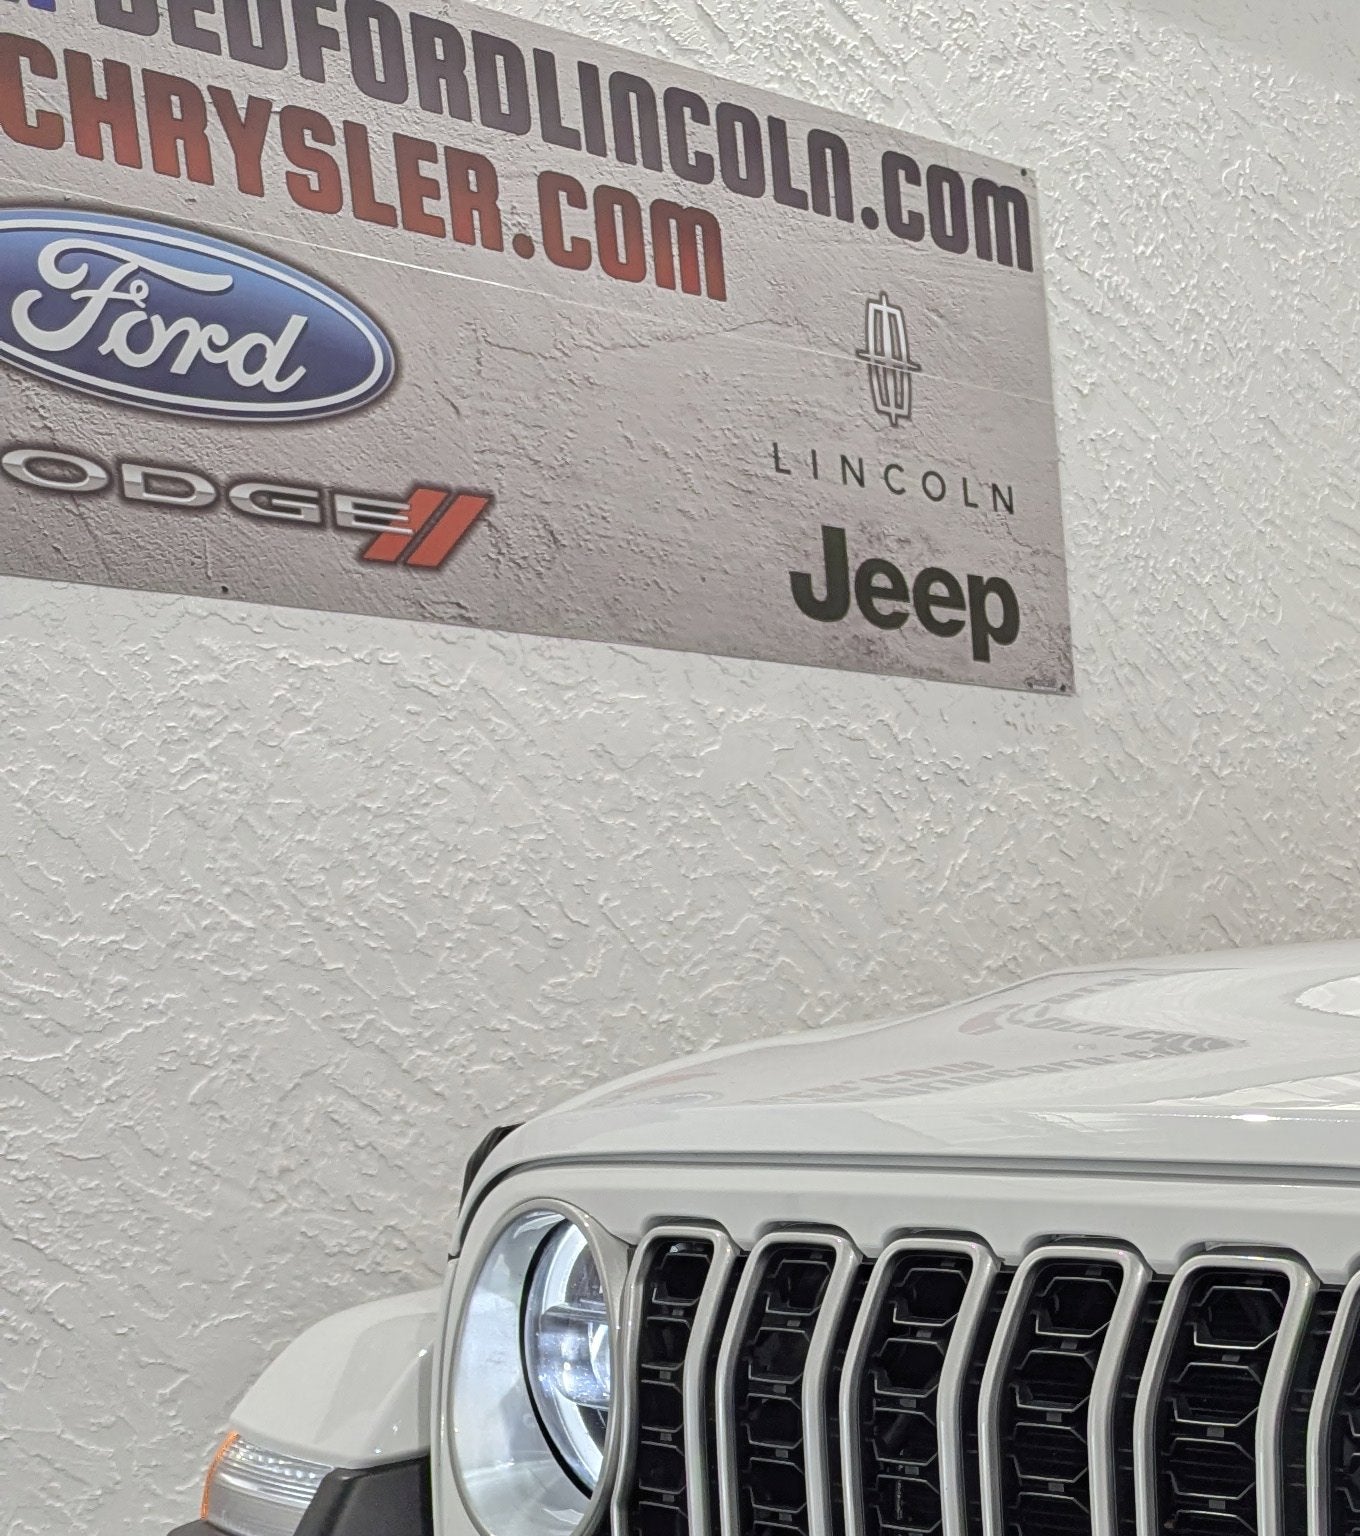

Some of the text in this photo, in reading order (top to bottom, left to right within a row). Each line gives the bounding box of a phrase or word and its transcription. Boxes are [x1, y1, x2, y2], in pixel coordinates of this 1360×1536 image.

[0, 31, 728, 303] CHRYSLER.COM
[10, 237, 308, 397] Ford
[1, 448, 415, 537] ODGE
[771, 441, 1016, 516] LINCOLN
[788, 524, 1021, 663] Jeep
